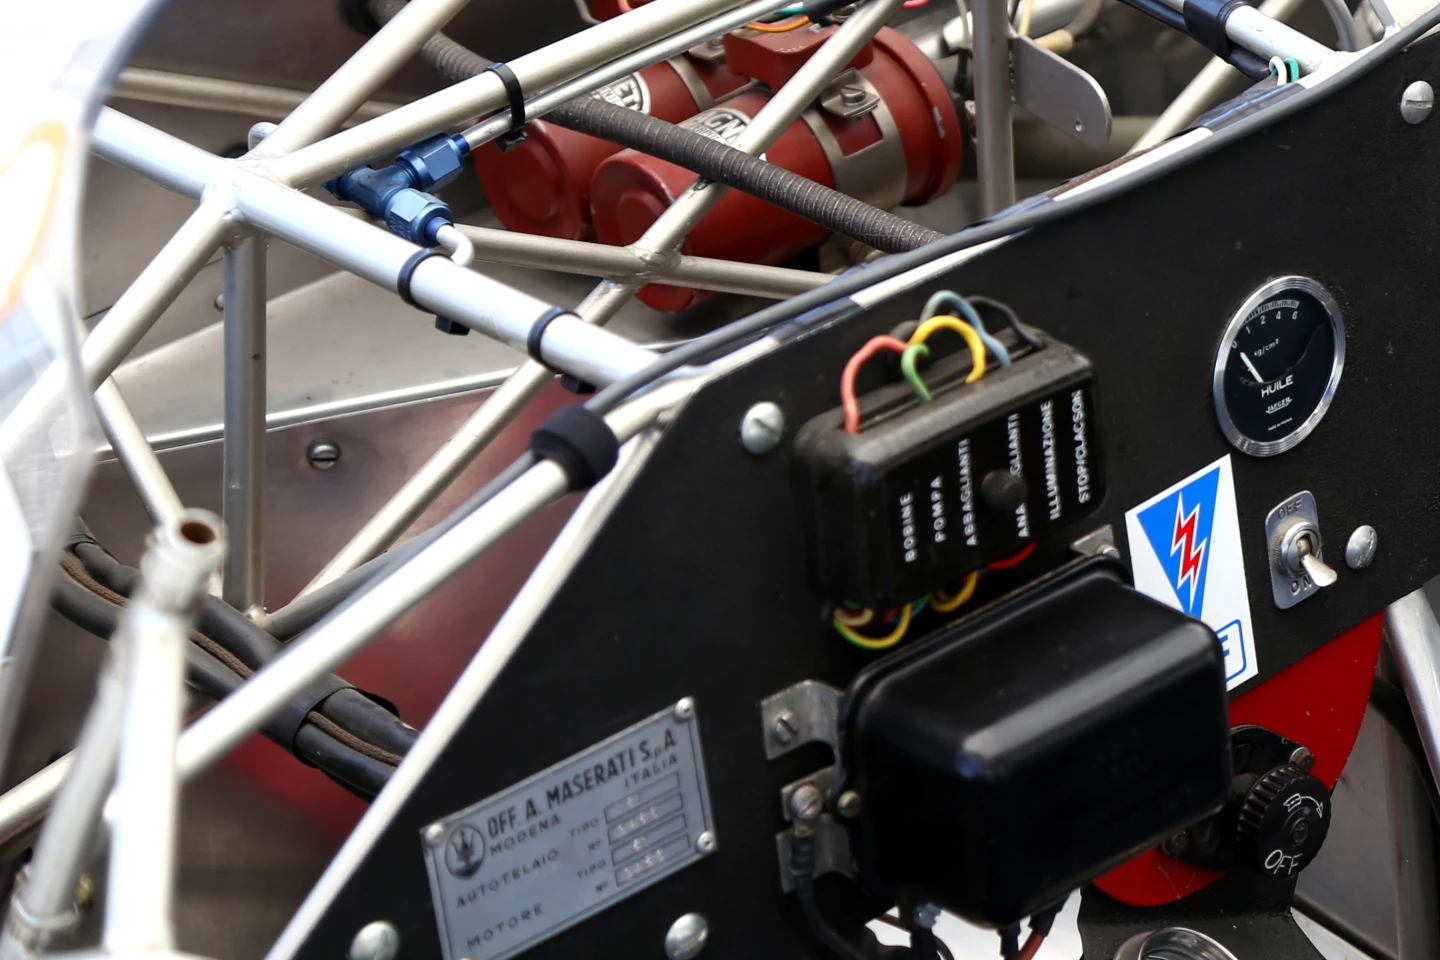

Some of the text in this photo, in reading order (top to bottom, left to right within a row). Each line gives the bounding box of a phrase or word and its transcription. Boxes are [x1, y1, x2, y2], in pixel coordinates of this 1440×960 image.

[1260, 315, 1266, 325] 2
[1275, 310, 1282, 320] 4
[1292, 310, 1298, 320] 6
[1261, 375, 1293, 398] HUILE
[1041, 399, 1062, 520] ILLUMINAZIONE
[931, 475, 947, 543] POMPA
[958, 439, 978, 546] ABBAGLIANTI
[1277, 497, 1303, 520] OFF
[900, 491, 918, 563] BOBINE
[1291, 576, 1312, 596] ON
[489, 755, 678, 856] MODENA ITALIA
[546, 749, 636, 809] MASERATI
[456, 849, 559, 909] AUTOTELAIO
[568, 818, 599, 838] TIPO
[1264, 849, 1303, 875] OFF
[466, 903, 544, 950] MOTORE
[577, 860, 606, 880] TIPO
